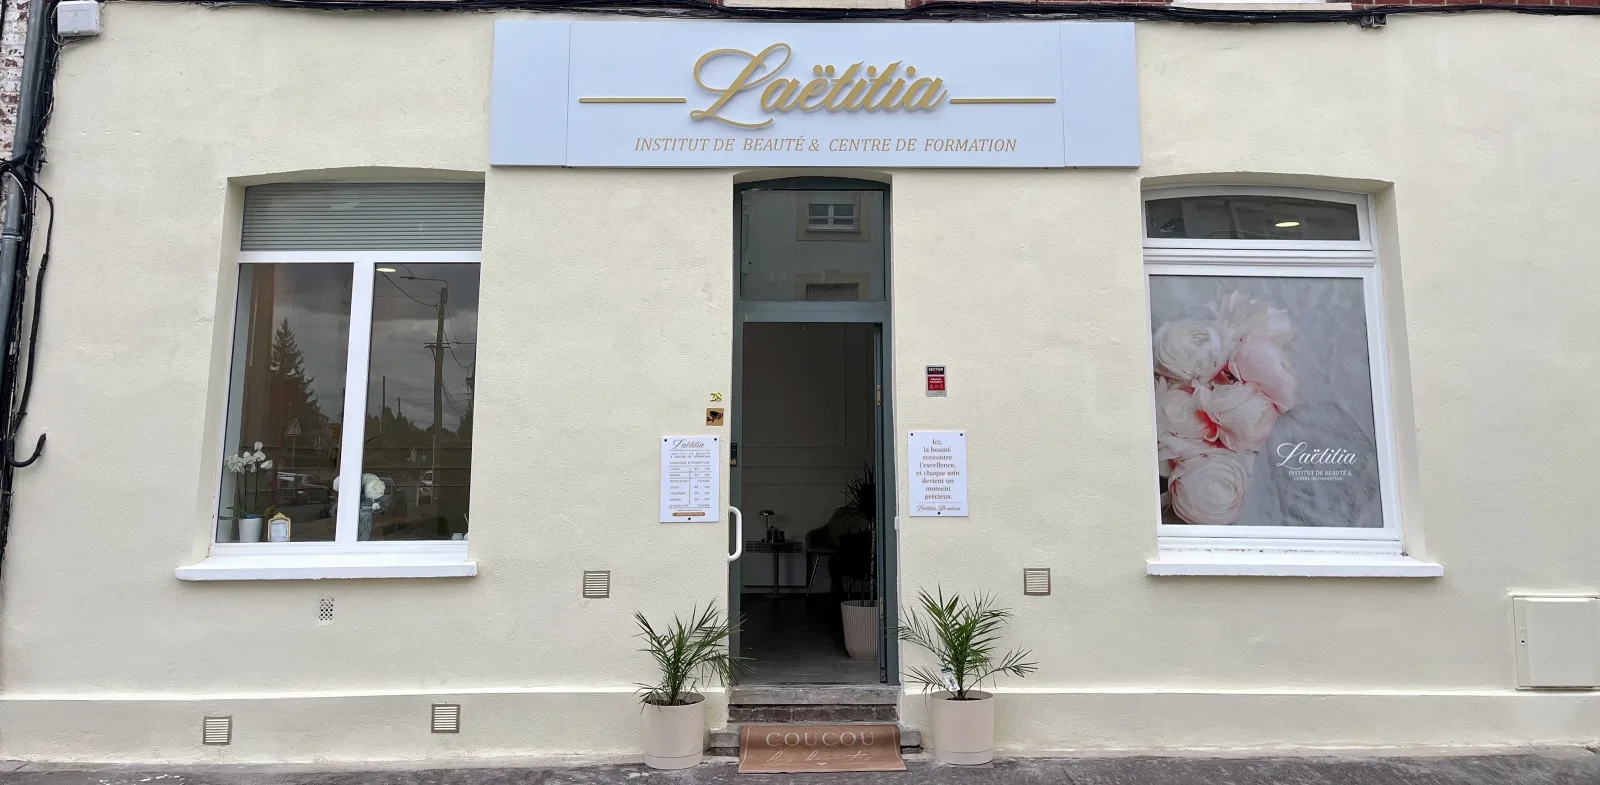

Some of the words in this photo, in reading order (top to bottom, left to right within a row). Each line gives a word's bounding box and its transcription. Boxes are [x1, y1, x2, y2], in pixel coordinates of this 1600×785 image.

[690, 43, 948, 129] Laëtitia
[635, 138, 710, 151] INSTITUT
[713, 138, 735, 151] DE
[743, 135, 805, 151] BEAUTÉ
[808, 139, 820, 151] &
[829, 138, 891, 151] CENTRE
[895, 138, 917, 151] DE
[924, 138, 1017, 151] FORMATION
[1276, 441, 1358, 470] Laëtitia
[923, 469, 946, 477] chaque
[924, 493, 953, 501] précieux.
[765, 731, 874, 746] COUCOU
